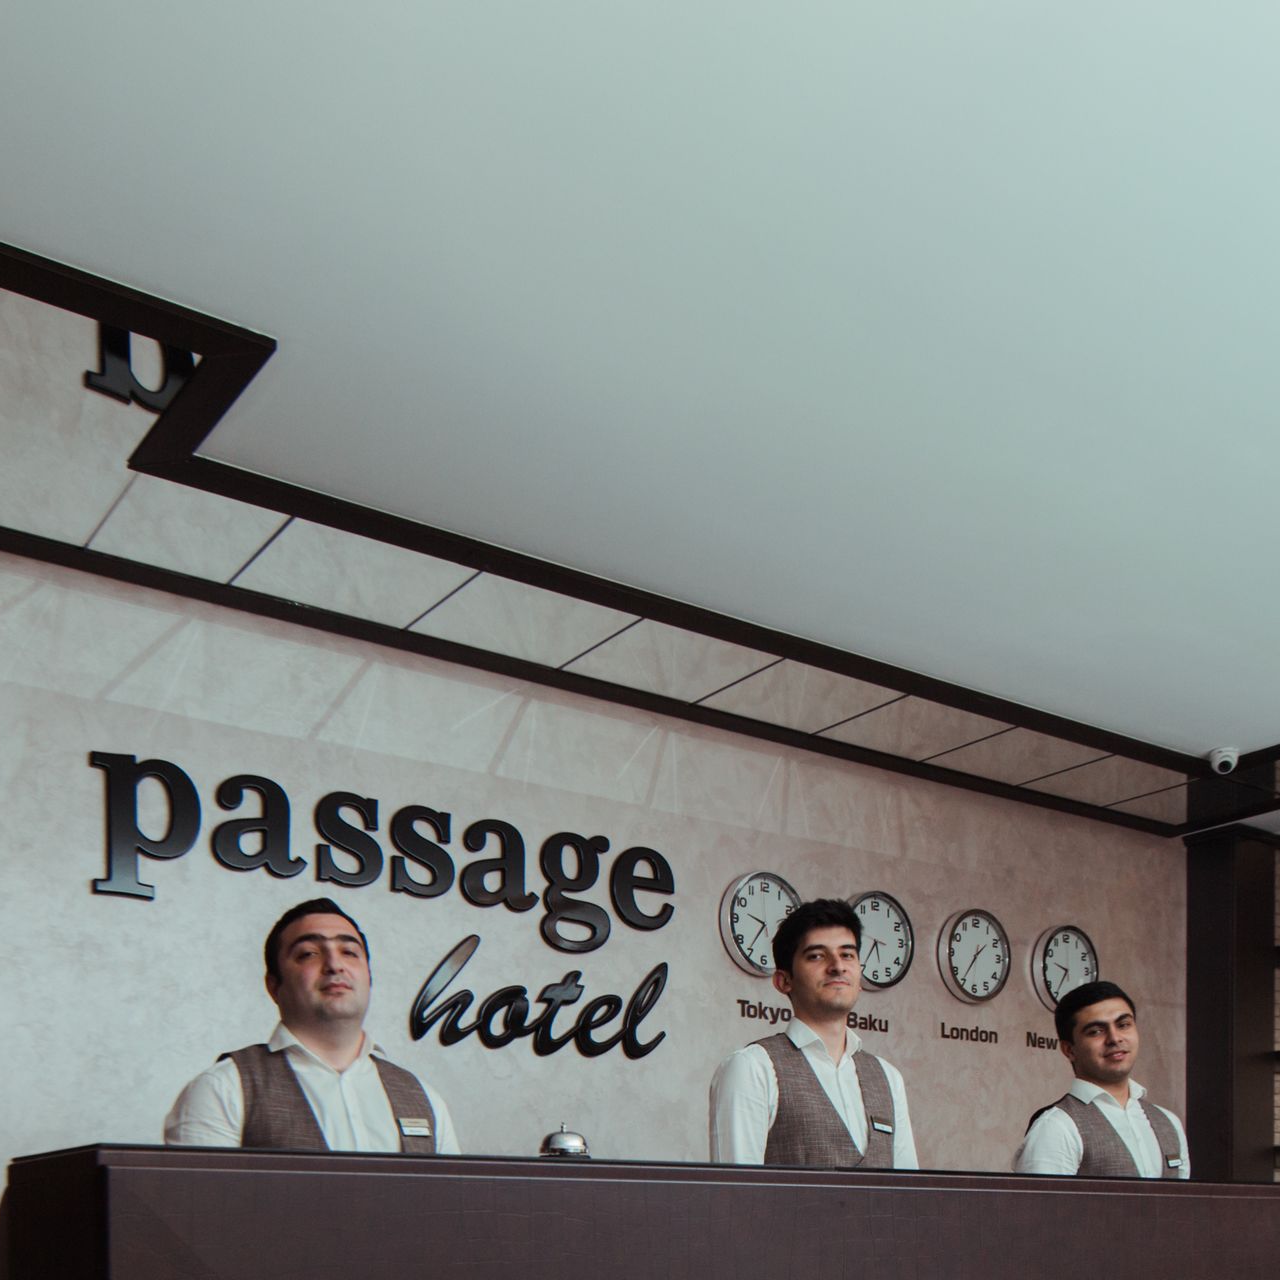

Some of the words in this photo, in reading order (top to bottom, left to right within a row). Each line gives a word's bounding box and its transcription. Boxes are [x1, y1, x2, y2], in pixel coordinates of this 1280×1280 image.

[89, 750, 675, 953] passage
[748, 885, 754, 896] 11
[760, 882, 770, 893] 12
[735, 896, 747, 908] 10
[870, 901, 880, 911] 12
[860, 904, 866, 914] 11
[894, 922, 900, 932] 2
[962, 922, 968, 932] 11
[971, 918, 980, 928] 12
[735, 934, 745, 945] 8
[898, 938, 904, 949] 3
[992, 939, 999, 948] 2
[1062, 934, 1070, 943] 12
[747, 947, 754, 958] 7
[1081, 952, 1087, 962] 2
[760, 955, 768, 965] 6
[893, 957, 900, 967] 4
[995, 954, 1001, 964] 3
[860, 964, 866, 974] 7
[885, 967, 892, 977] 5
[953, 966, 959, 976] 8
[1084, 967, 1090, 976] 3
[872, 970, 879, 980] 6
[991, 972, 998, 980] 4
[960, 978, 967, 987] 7
[983, 981, 989, 991] 5
[971, 984, 978, 994] 6
[410, 934, 669, 1059] hotel
[736, 999, 792, 1025] Tokyo
[846, 1012, 889, 1033] Baku
[941, 1022, 999, 1044] London
[1026, 1031, 1058, 1051] New
